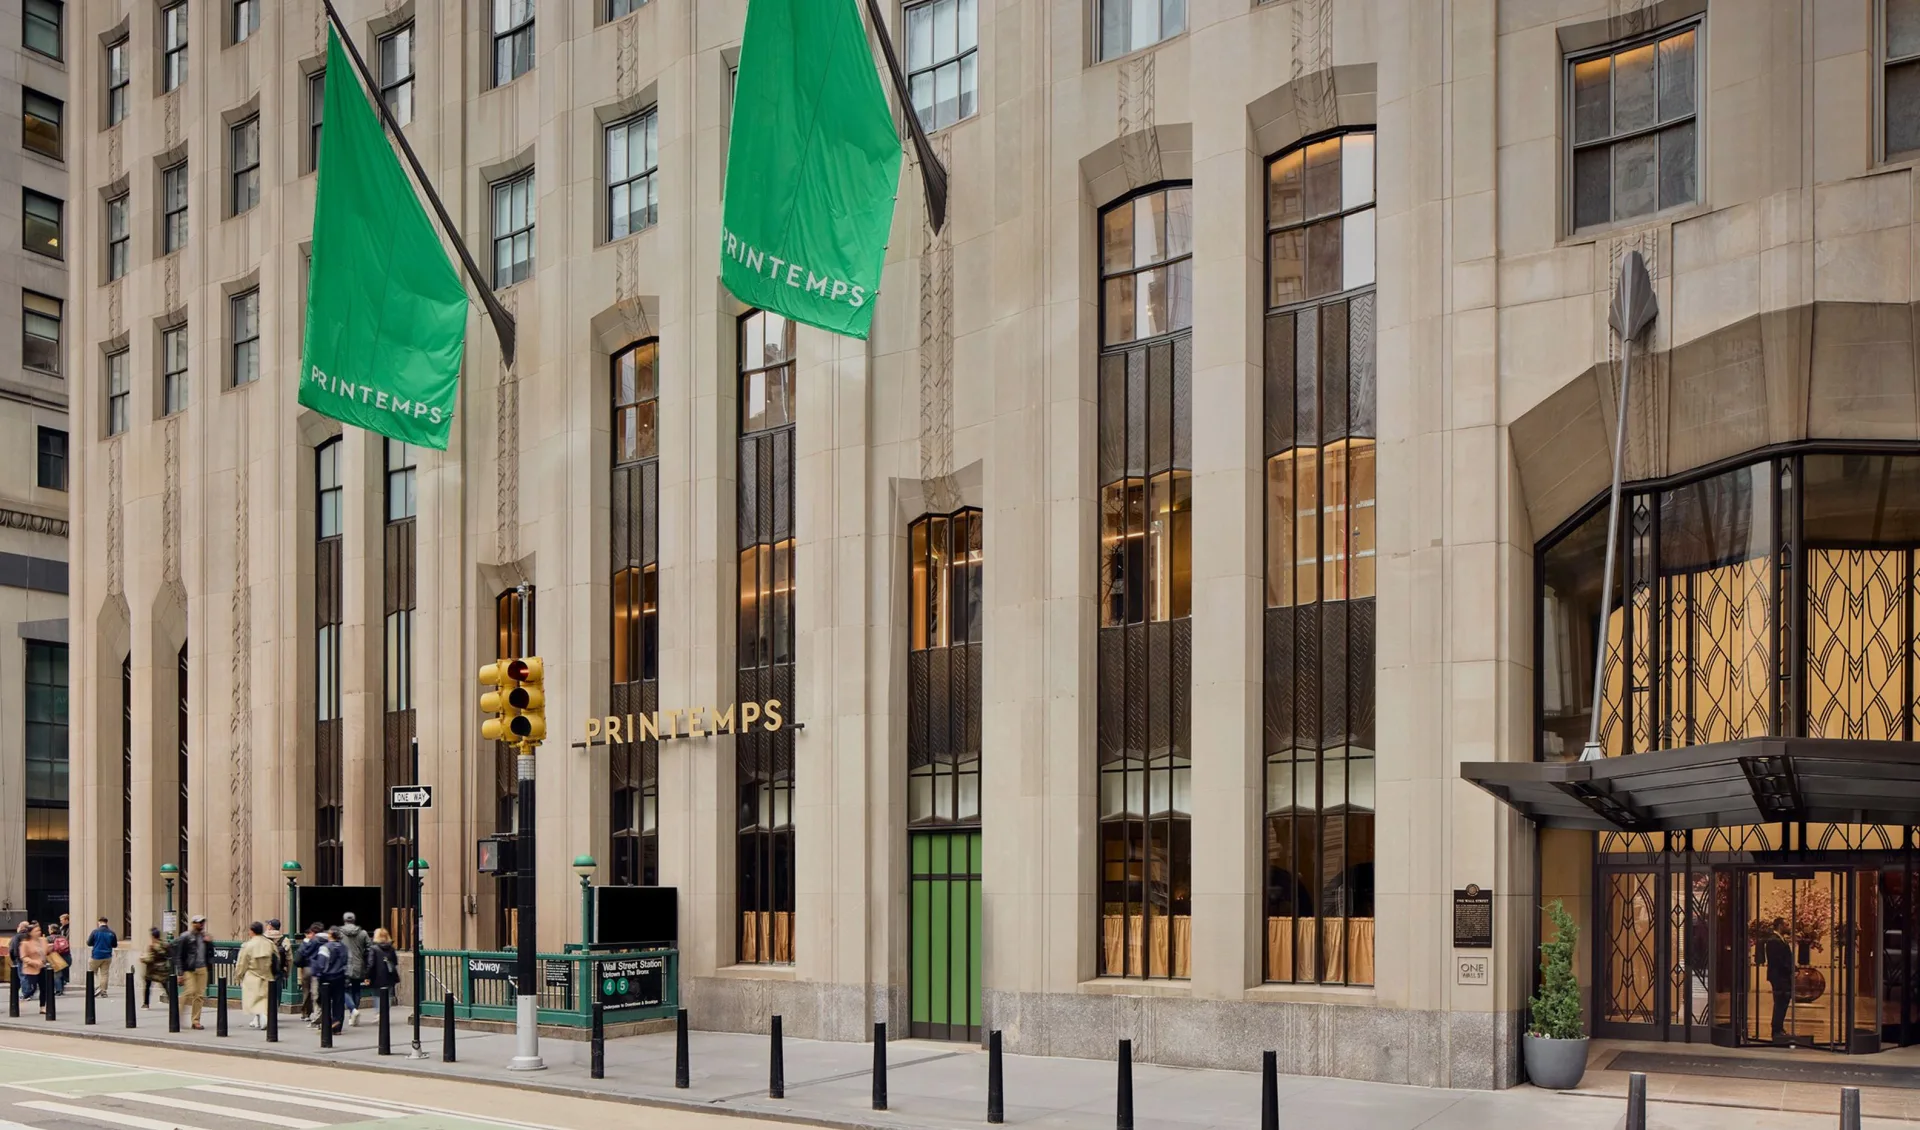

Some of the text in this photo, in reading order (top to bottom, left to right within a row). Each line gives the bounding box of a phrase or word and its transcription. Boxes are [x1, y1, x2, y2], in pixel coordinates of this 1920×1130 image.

[311, 365, 443, 425] PRINTEMPS
[584, 699, 783, 747] PRINTEMPS
[397, 793, 426, 802] ONE WAY
[469, 959, 500, 974] Subway
[603, 960, 661, 971] Wall Street Station
[1461, 963, 1484, 972] ONE
